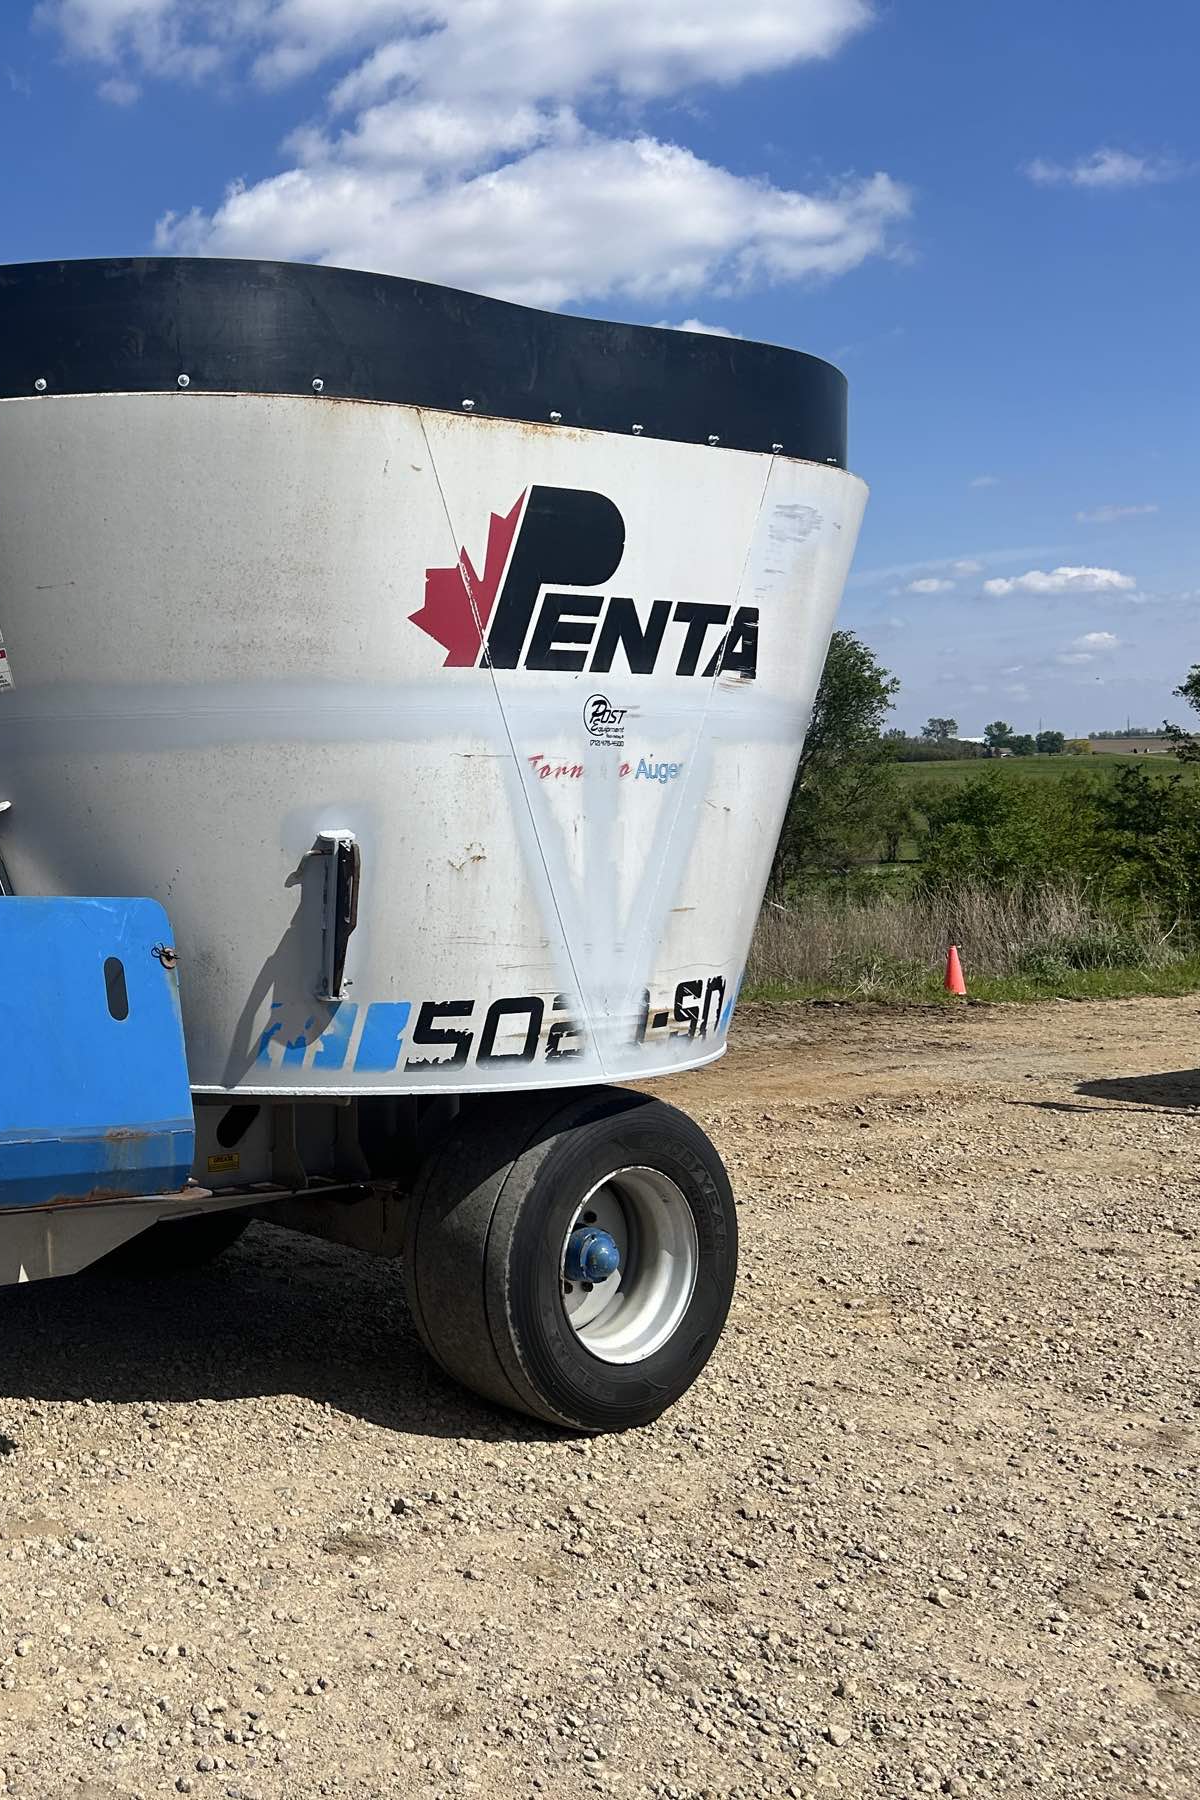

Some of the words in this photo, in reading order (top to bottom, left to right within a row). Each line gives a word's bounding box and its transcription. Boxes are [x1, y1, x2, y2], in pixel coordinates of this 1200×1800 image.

[479, 484, 759, 680] PENTA
[589, 699, 628, 724] POST
[528, 755, 633, 780] Torno
